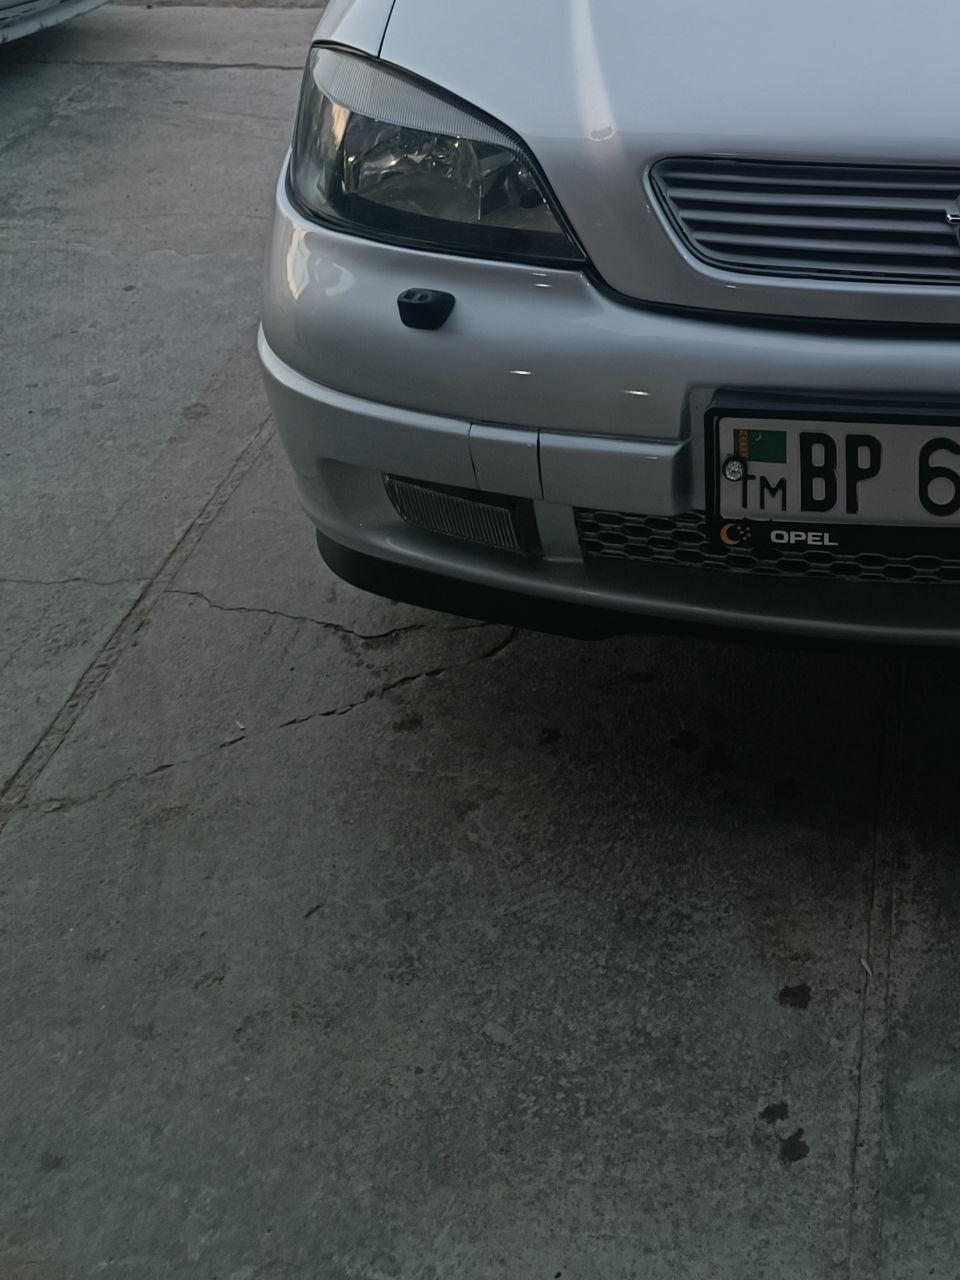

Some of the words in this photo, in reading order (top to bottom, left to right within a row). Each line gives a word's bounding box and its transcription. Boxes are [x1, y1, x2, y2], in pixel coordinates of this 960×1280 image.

[799, 432, 882, 514] BP
[741, 474, 787, 511] TM
[770, 530, 839, 546] OPEL
